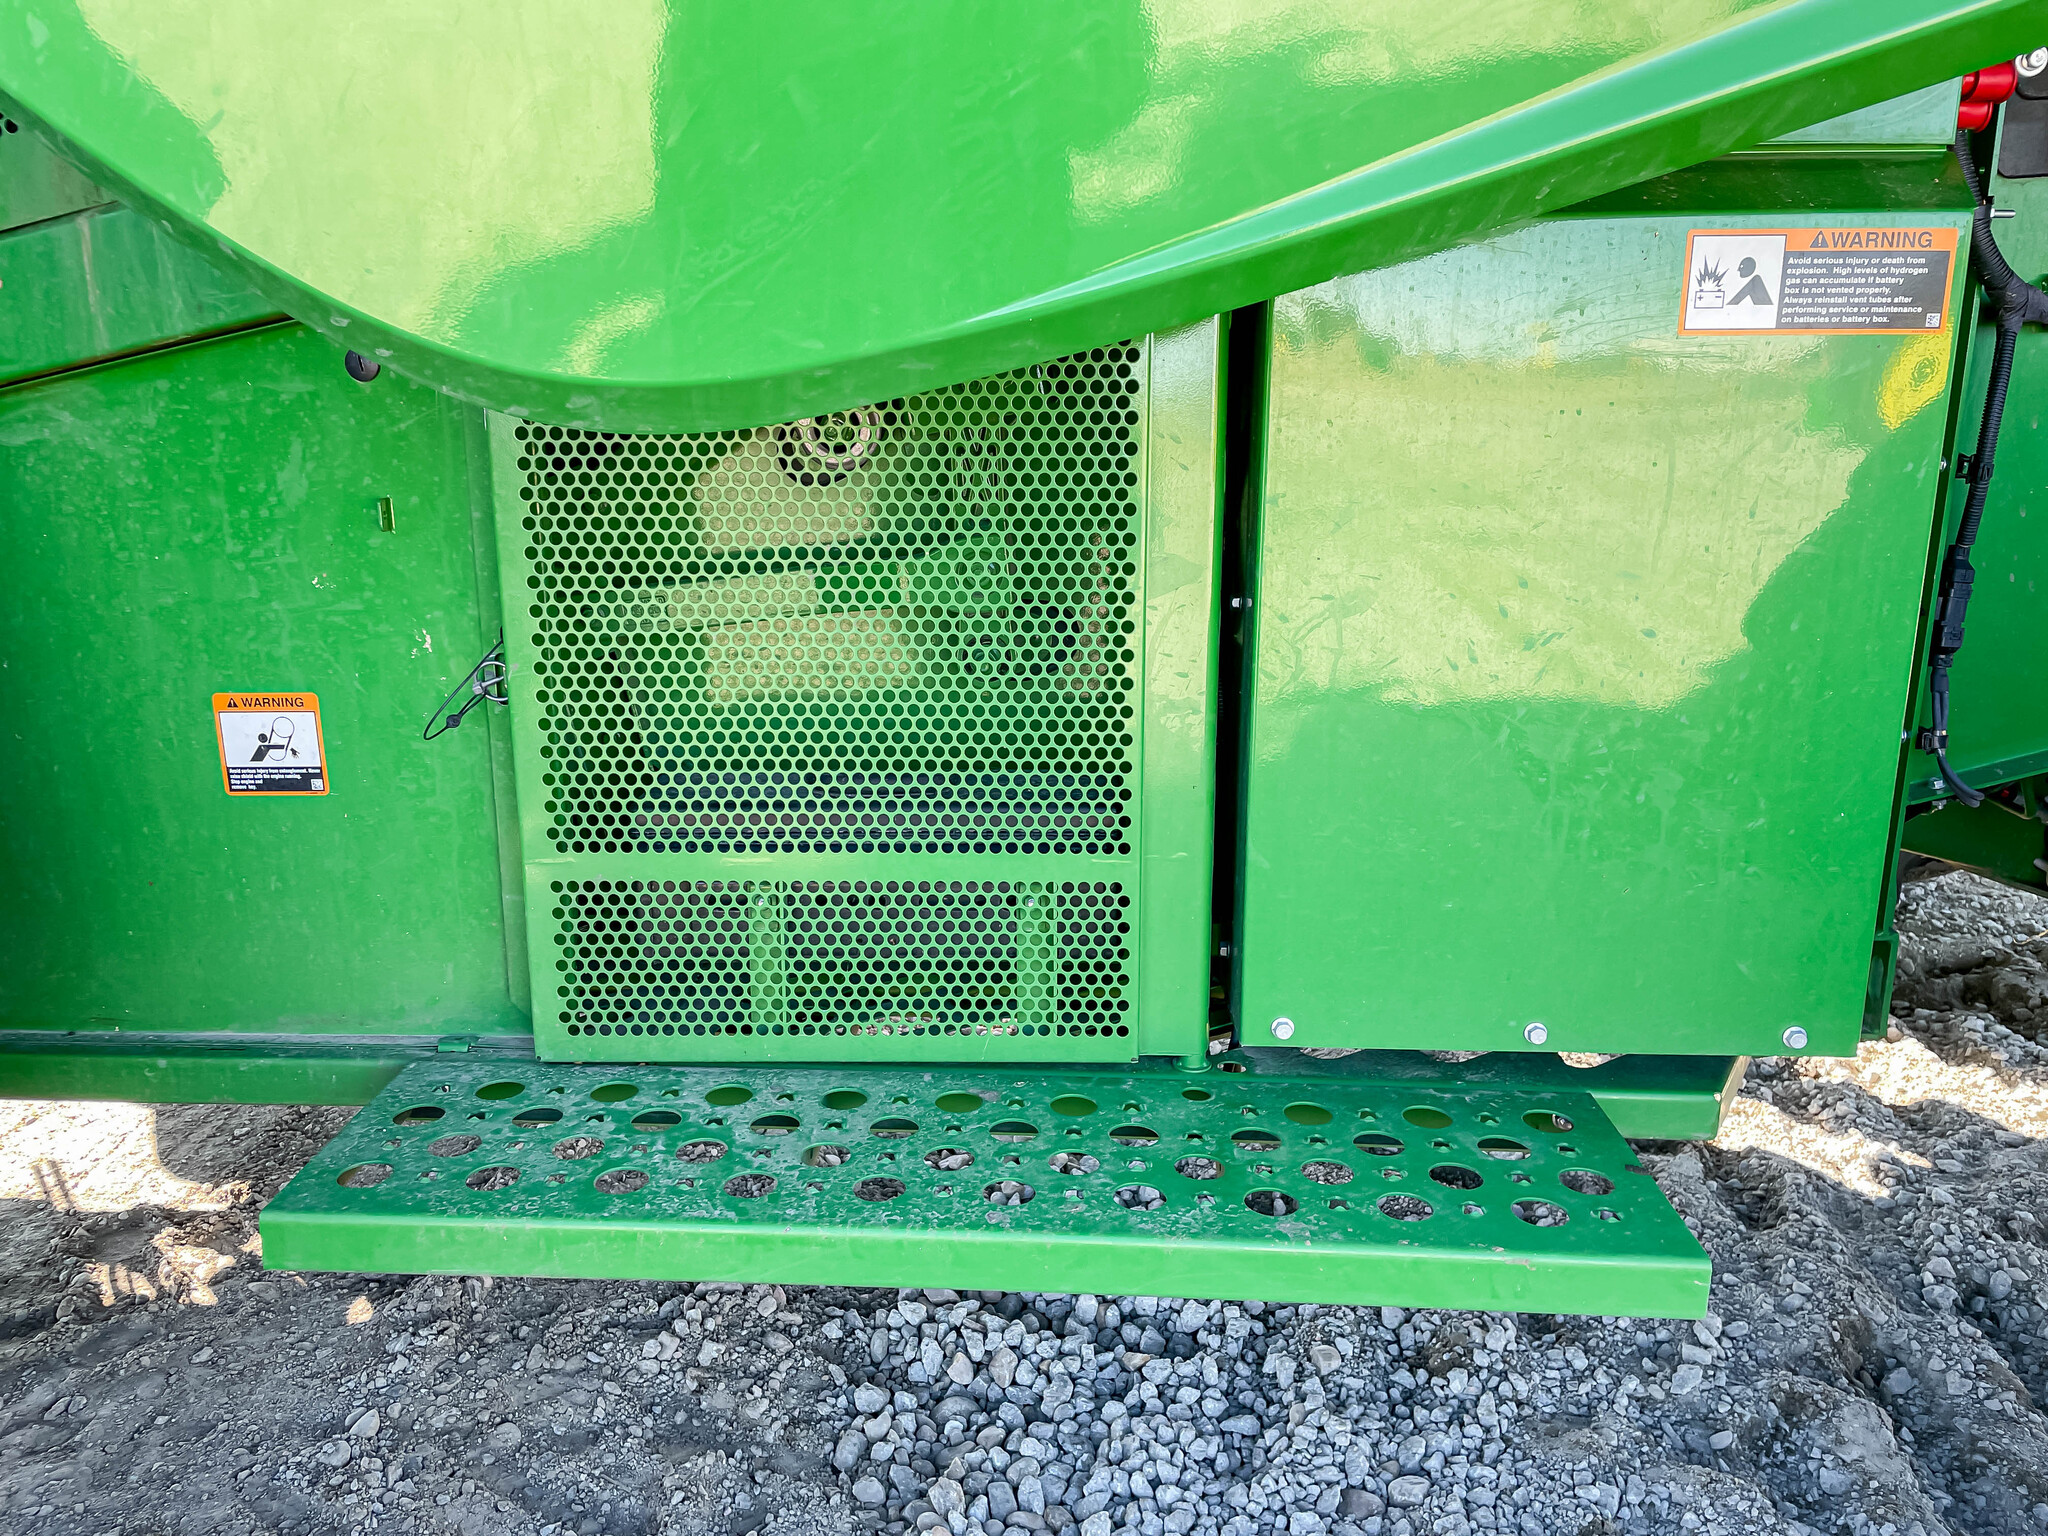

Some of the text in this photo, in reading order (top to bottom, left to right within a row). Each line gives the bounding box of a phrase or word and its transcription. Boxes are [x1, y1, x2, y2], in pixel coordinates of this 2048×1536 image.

[1831, 231, 1933, 248] WARNING
[1846, 257, 1869, 266] injury
[1787, 267, 1828, 275] explosion.
[1833, 267, 1852, 275] High
[1890, 267, 1928, 275] hydrogen
[1786, 277, 1800, 285] gas
[1876, 277, 1904, 285] battery
[1856, 287, 1891, 295] properly.
[1784, 297, 1812, 305] Always
[1782, 306, 1826, 315] performing
[1842, 316, 1870, 324] battery
[241, 698, 304, 707] WARNING
